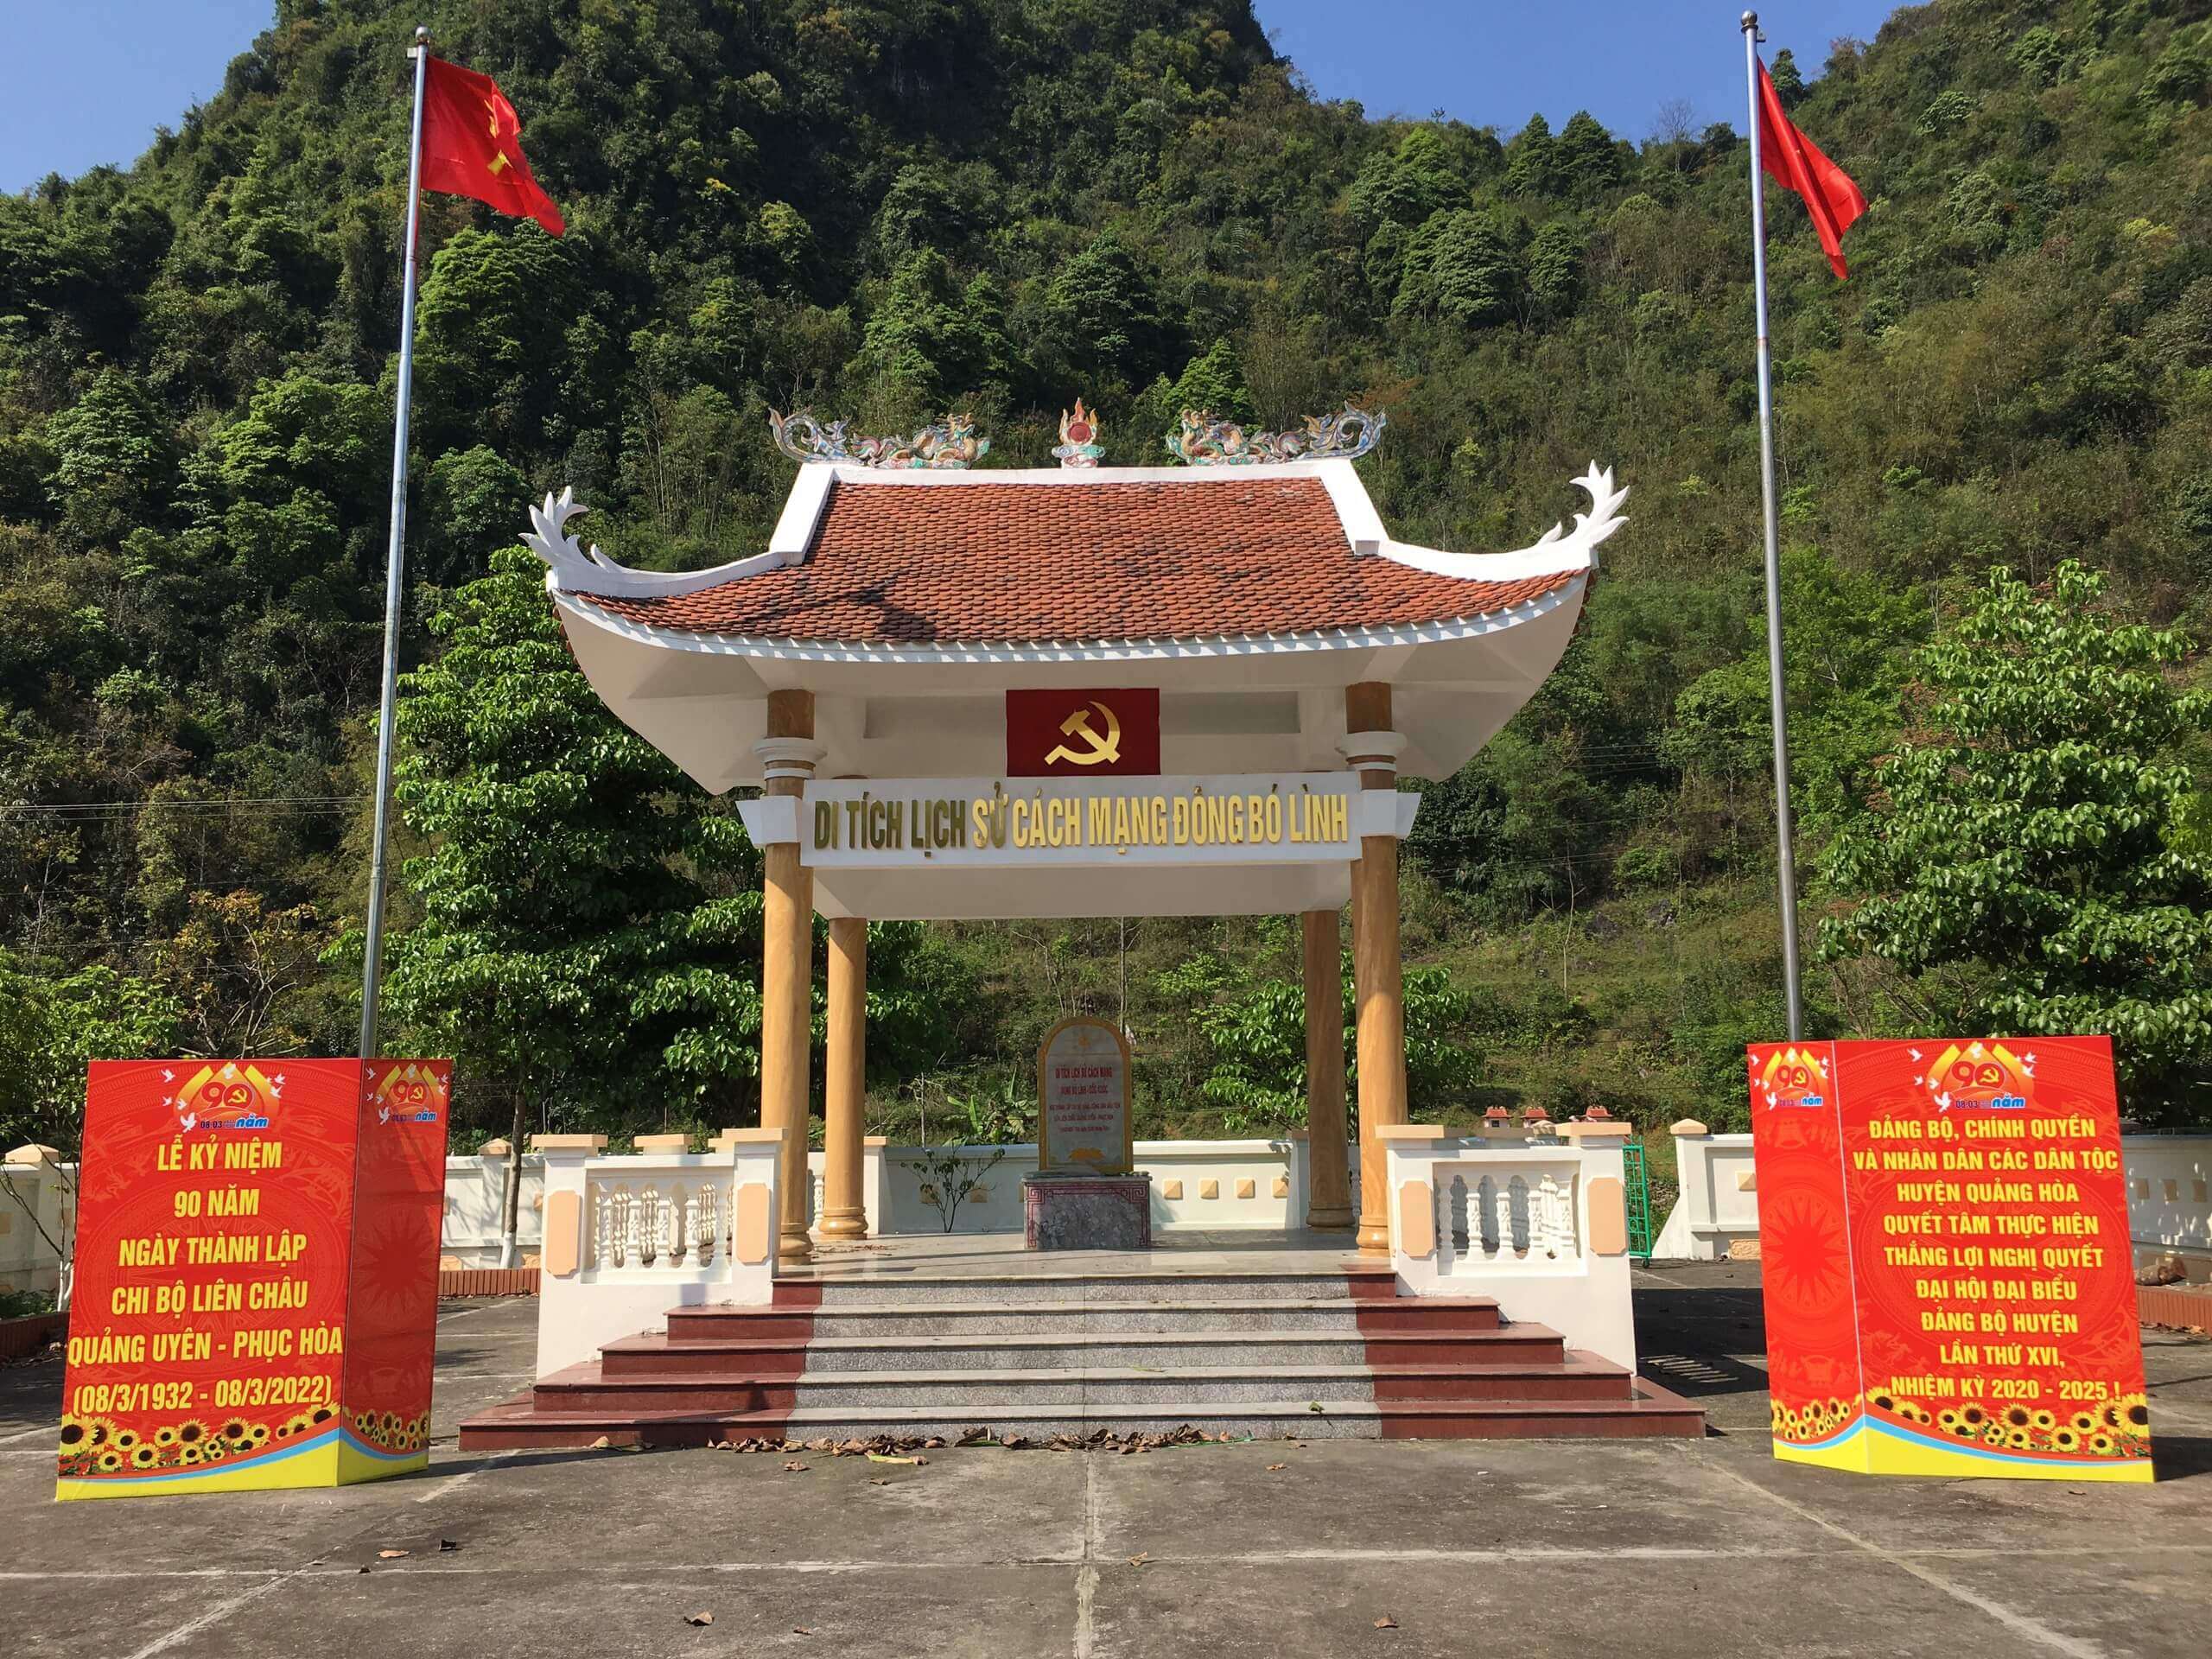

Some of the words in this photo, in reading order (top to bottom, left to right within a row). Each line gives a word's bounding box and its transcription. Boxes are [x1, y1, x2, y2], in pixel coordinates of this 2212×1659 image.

[814, 800, 839, 849] DI
[846, 791, 903, 849] TÍCH
[912, 799, 965, 858] LỊCH
[972, 781, 1008, 849] SỬ
[1013, 788, 1081, 849] CÁCH
[1089, 796, 1167, 855] MẠNG
[1249, 784, 1281, 843] BÓ
[1289, 784, 1348, 842] LÌNH
[1991, 1092, 2025, 1109] năm
[235, 1113, 269, 1128] năm
[1869, 1114, 1922, 1139] ĐẢNG
[1928, 1116, 1960, 1142] BỘ,
[1965, 1115, 2024, 1138] CHÍNH
[2031, 1112, 2096, 1139] QUYỀN
[157, 1134, 183, 1171] LỄ
[189, 1134, 218, 1170] KỶ
[225, 1136, 283, 1174] NIỆM
[1853, 1148, 1878, 1170] VÀ
[1883, 1148, 1937, 1170] NHÂN
[1943, 1147, 1983, 1170] DÂN
[1989, 1147, 2028, 1170] CÁC
[2034, 1147, 2075, 1170] DÂN
[2080, 1147, 2119, 1173] TỘC
[174, 1191, 201, 1217] 90
[207, 1184, 259, 1217] NĂM
[1897, 1179, 1961, 1205] HUYỆN
[1966, 1177, 2033, 1204] QUẢNG
[2038, 1179, 2080, 1202] HÒA
[1884, 1210, 1942, 1236] QUYẾT
[1948, 1211, 1991, 1235] TÂM
[1995, 1213, 2046, 1238] THỰC
[2052, 1211, 2099, 1238] HIỆN
[118, 1232, 180, 1267] NGÀY
[187, 1230, 259, 1264] THÀNH
[265, 1229, 307, 1268] LẬP
[1954, 1245, 1984, 1271] LỢI
[1990, 1248, 2037, 1271] NGHỊ
[2043, 1243, 2103, 1268] QUYẾT
[111, 1287, 149, 1314] CHI
[156, 1280, 186, 1319] BỘ
[193, 1278, 242, 1312] LIÊN
[249, 1275, 308, 1310] CHÂU
[1916, 1279, 1948, 1302] ĐẠI
[1954, 1276, 1986, 1303] HỘI
[1993, 1280, 2026, 1304] ĐẠI
[2031, 1274, 2077, 1300] BIỂU
[1921, 1306, 1975, 1332] ĐẢNG
[1980, 1309, 2007, 1337] BỘ
[2012, 1310, 2079, 1337] HUYỆN
[68, 1326, 145, 1368] QUẢNG
[152, 1327, 211, 1362] UYÊN
[233, 1328, 292, 1363] PHỤC
[300, 1320, 342, 1355] HÒA
[1940, 1338, 1978, 1364] LẦN
[1984, 1343, 2022, 1365] THỨ
[2027, 1347, 2065, 1368] XVI,
[73, 1381, 194, 1416] (08/3/1932
[214, 1375, 333, 1408] 08/3/2022)
[1891, 1374, 1955, 1401] NHIỆM
[1961, 1375, 1985, 1398] KỲ
[1991, 1379, 2039, 1399] 2020
[2059, 1381, 2107, 1401] 2025
